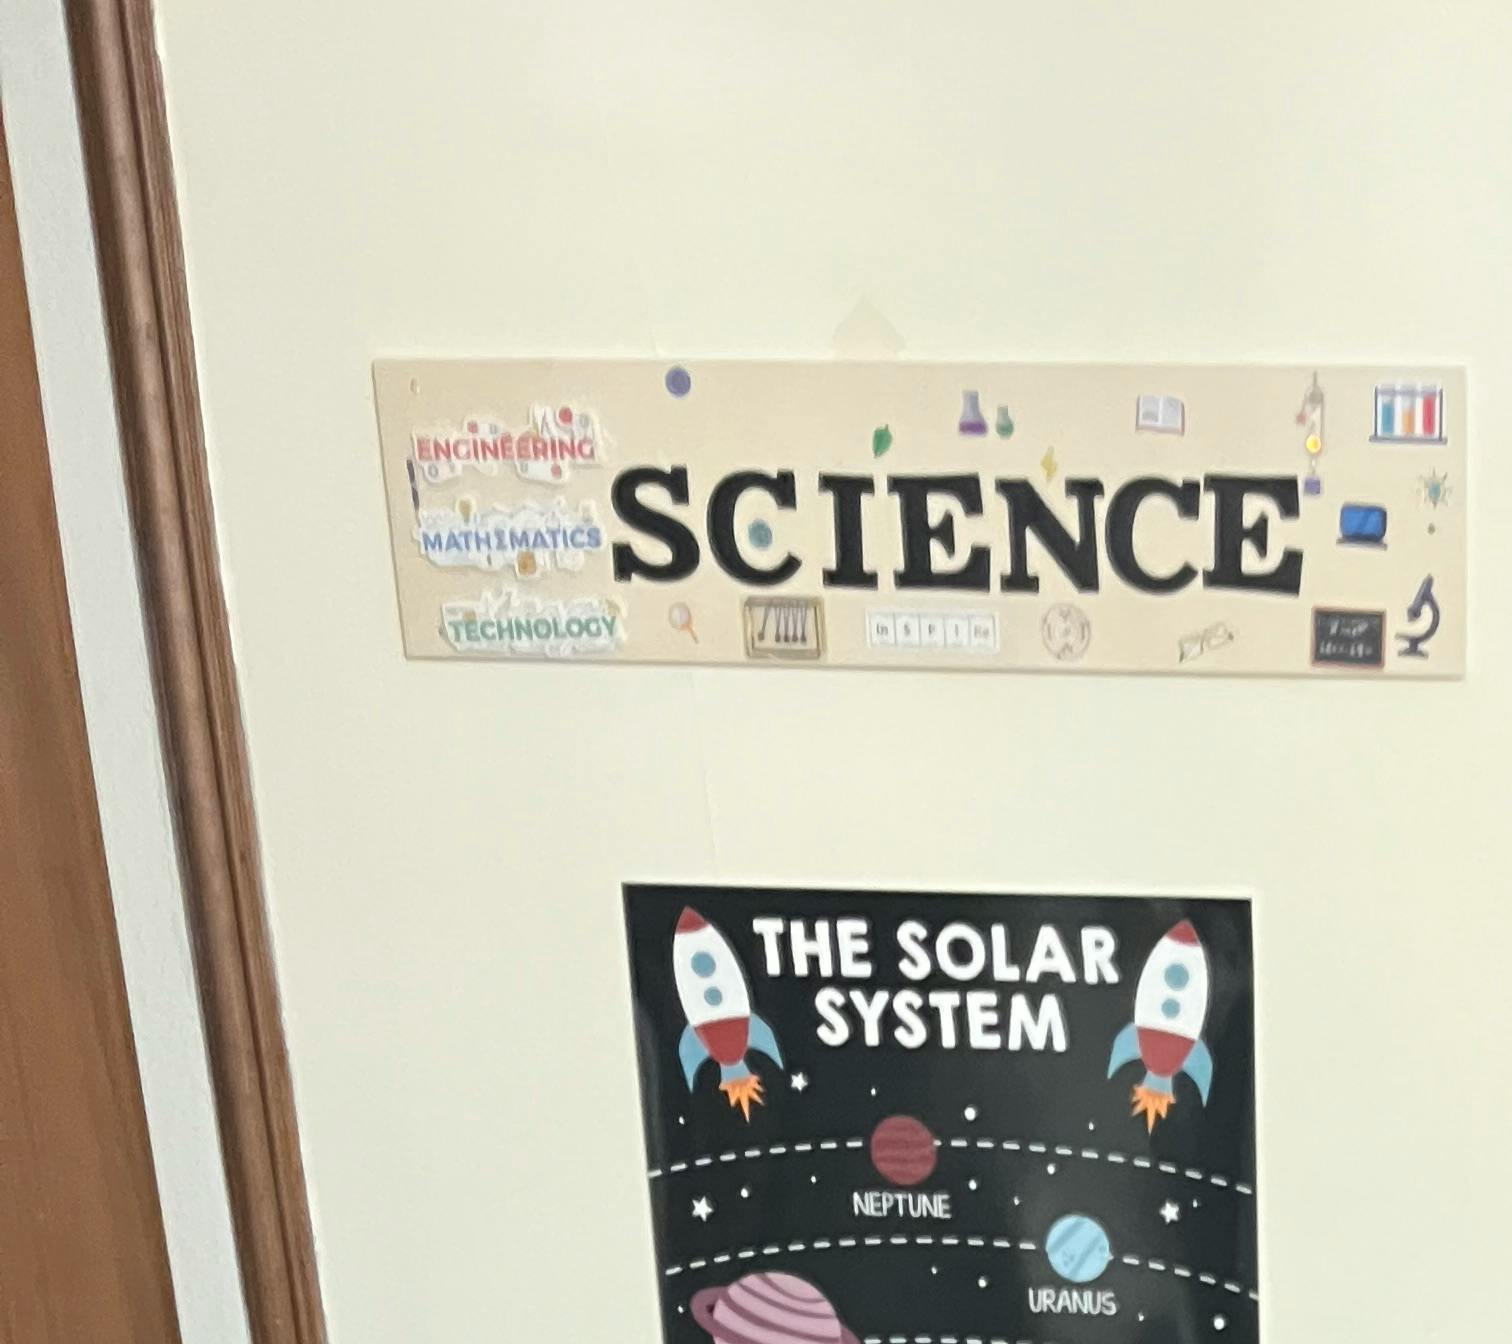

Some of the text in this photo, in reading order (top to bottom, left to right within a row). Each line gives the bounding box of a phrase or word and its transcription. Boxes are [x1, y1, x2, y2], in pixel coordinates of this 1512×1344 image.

[416, 432, 596, 462] ENGINEERING
[610, 465, 1304, 598] SCIENCE
[450, 615, 616, 642] TECHNOLOGY
[752, 917, 1120, 984] THE SOLAR
[814, 987, 1068, 1052] SYSTEM
[853, 1191, 951, 1219] NEPTUNE
[1029, 1287, 1117, 1315] URANUS
